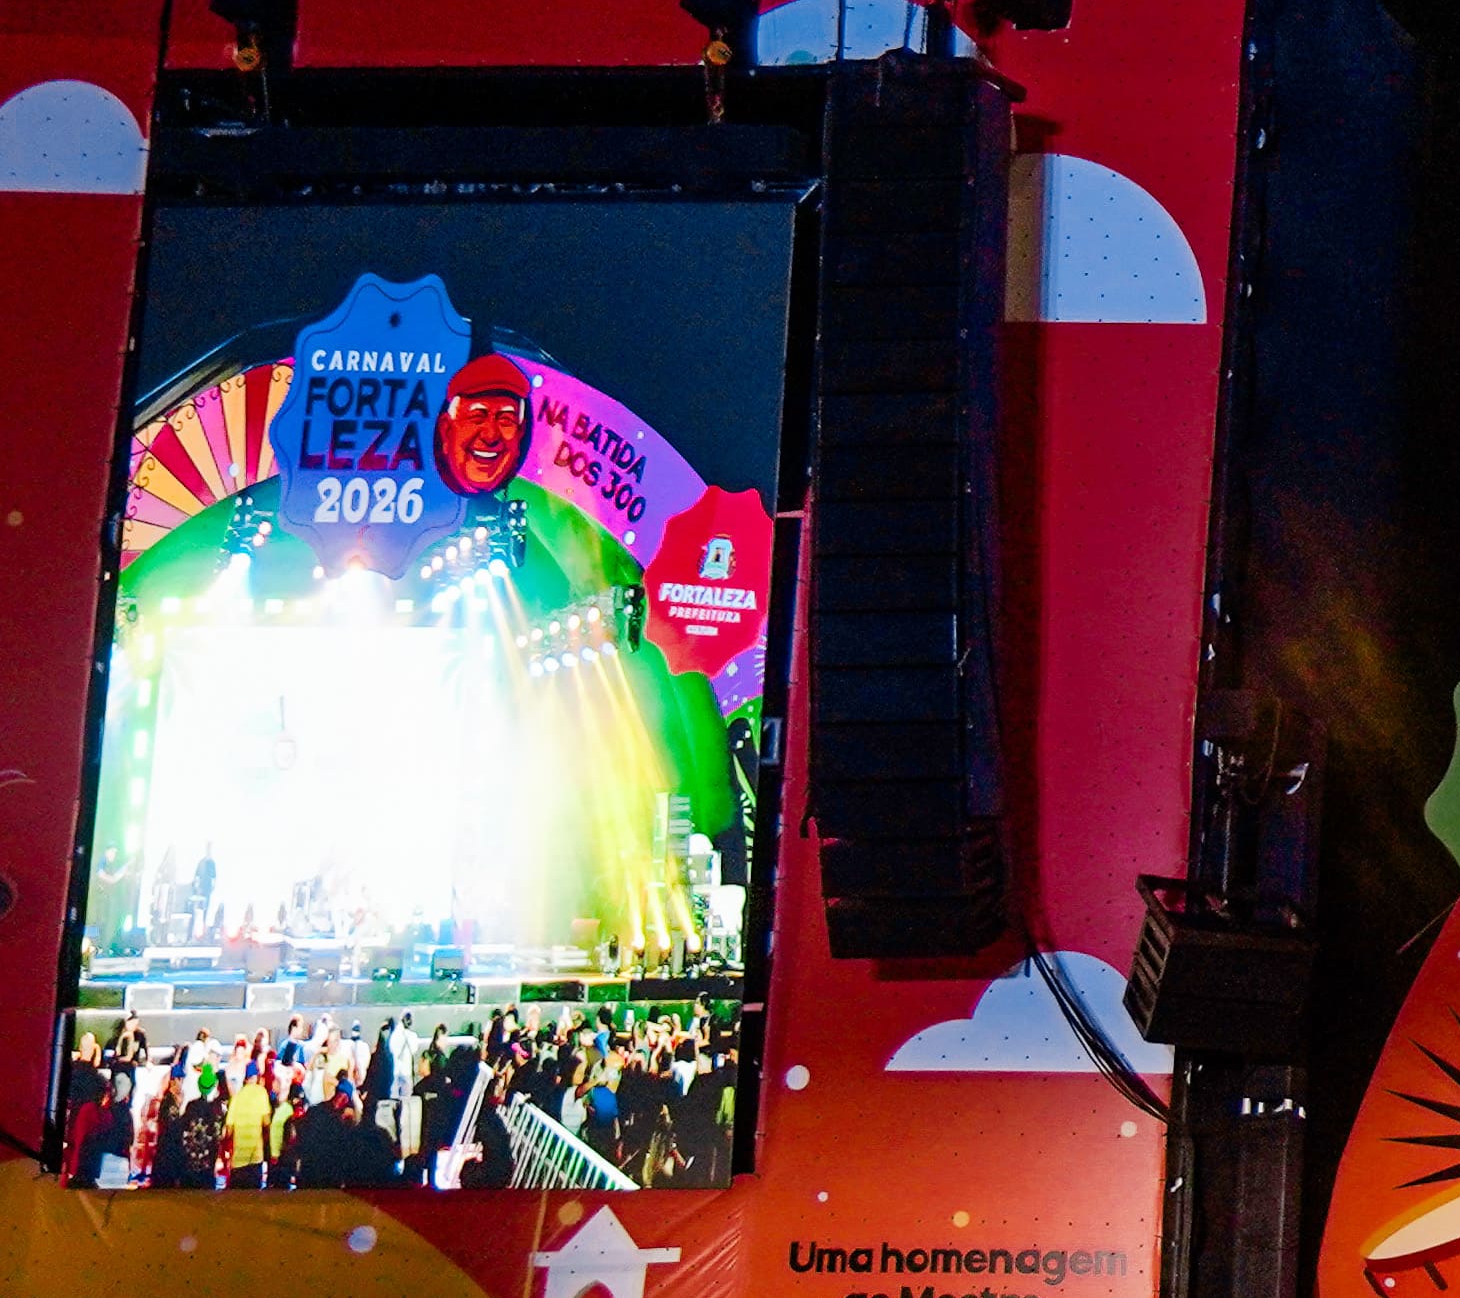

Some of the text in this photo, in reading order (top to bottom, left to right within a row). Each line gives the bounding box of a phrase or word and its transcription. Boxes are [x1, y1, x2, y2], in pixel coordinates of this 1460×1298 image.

[311, 349, 446, 374] CARNAVAL
[305, 376, 430, 419] FORTA
[299, 419, 424, 471] LEZA
[536, 395, 648, 484] NA BATIDA
[314, 476, 425, 524] 2026
[553, 440, 647, 523] DOS 300
[658, 582, 757, 610] FORTALEZA
[668, 605, 741, 623] PREFEITURA
[789, 1241, 1128, 1286] Uma homenagem
